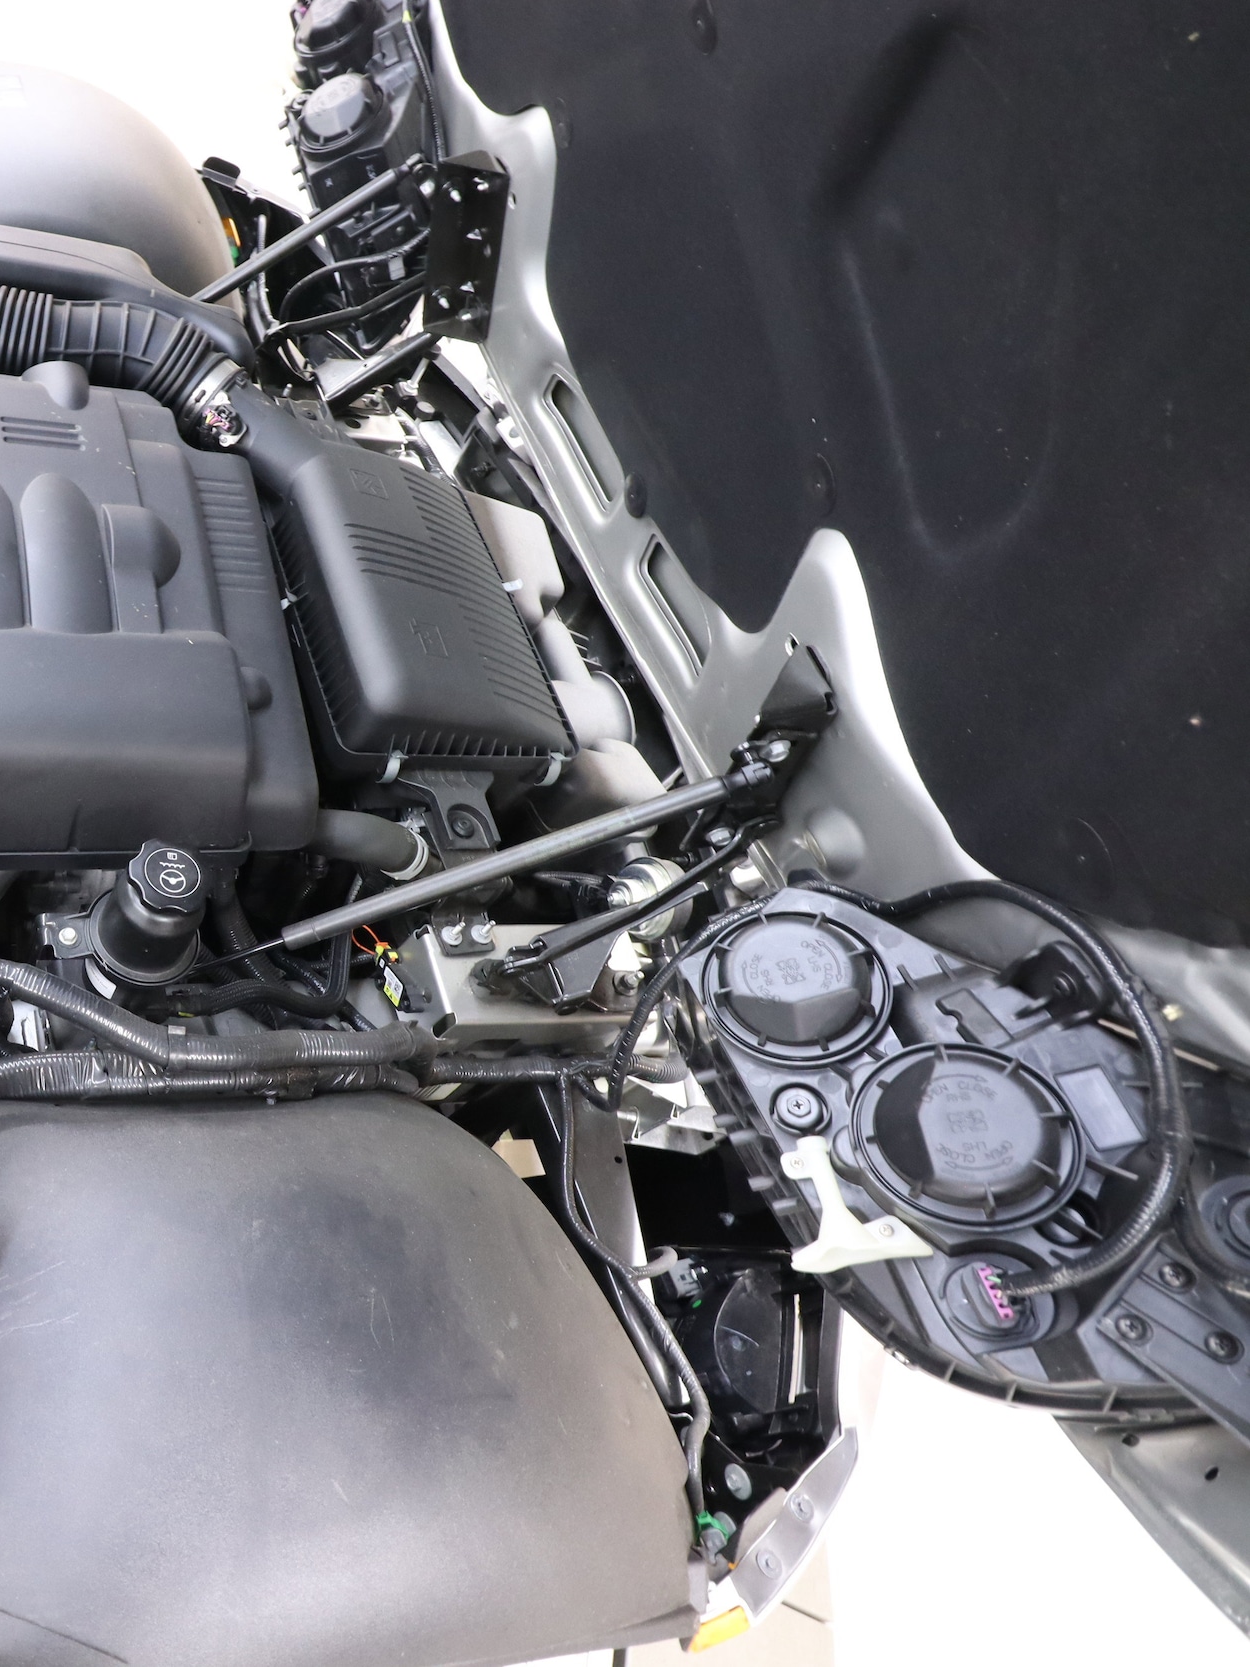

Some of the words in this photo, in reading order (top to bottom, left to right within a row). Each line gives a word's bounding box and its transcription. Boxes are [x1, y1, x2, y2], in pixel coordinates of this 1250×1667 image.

[750, 953, 763, 980] CLOSE
[801, 940, 826, 957] OPEN
[820, 962, 833, 990] CLOSE
[922, 1083, 949, 1103] OPEN
[957, 1081, 998, 1101] CLOSE
[935, 1143, 976, 1163] CLOSE
[962, 1141, 987, 1151] LHS
[985, 1140, 1013, 1160] OPEN
